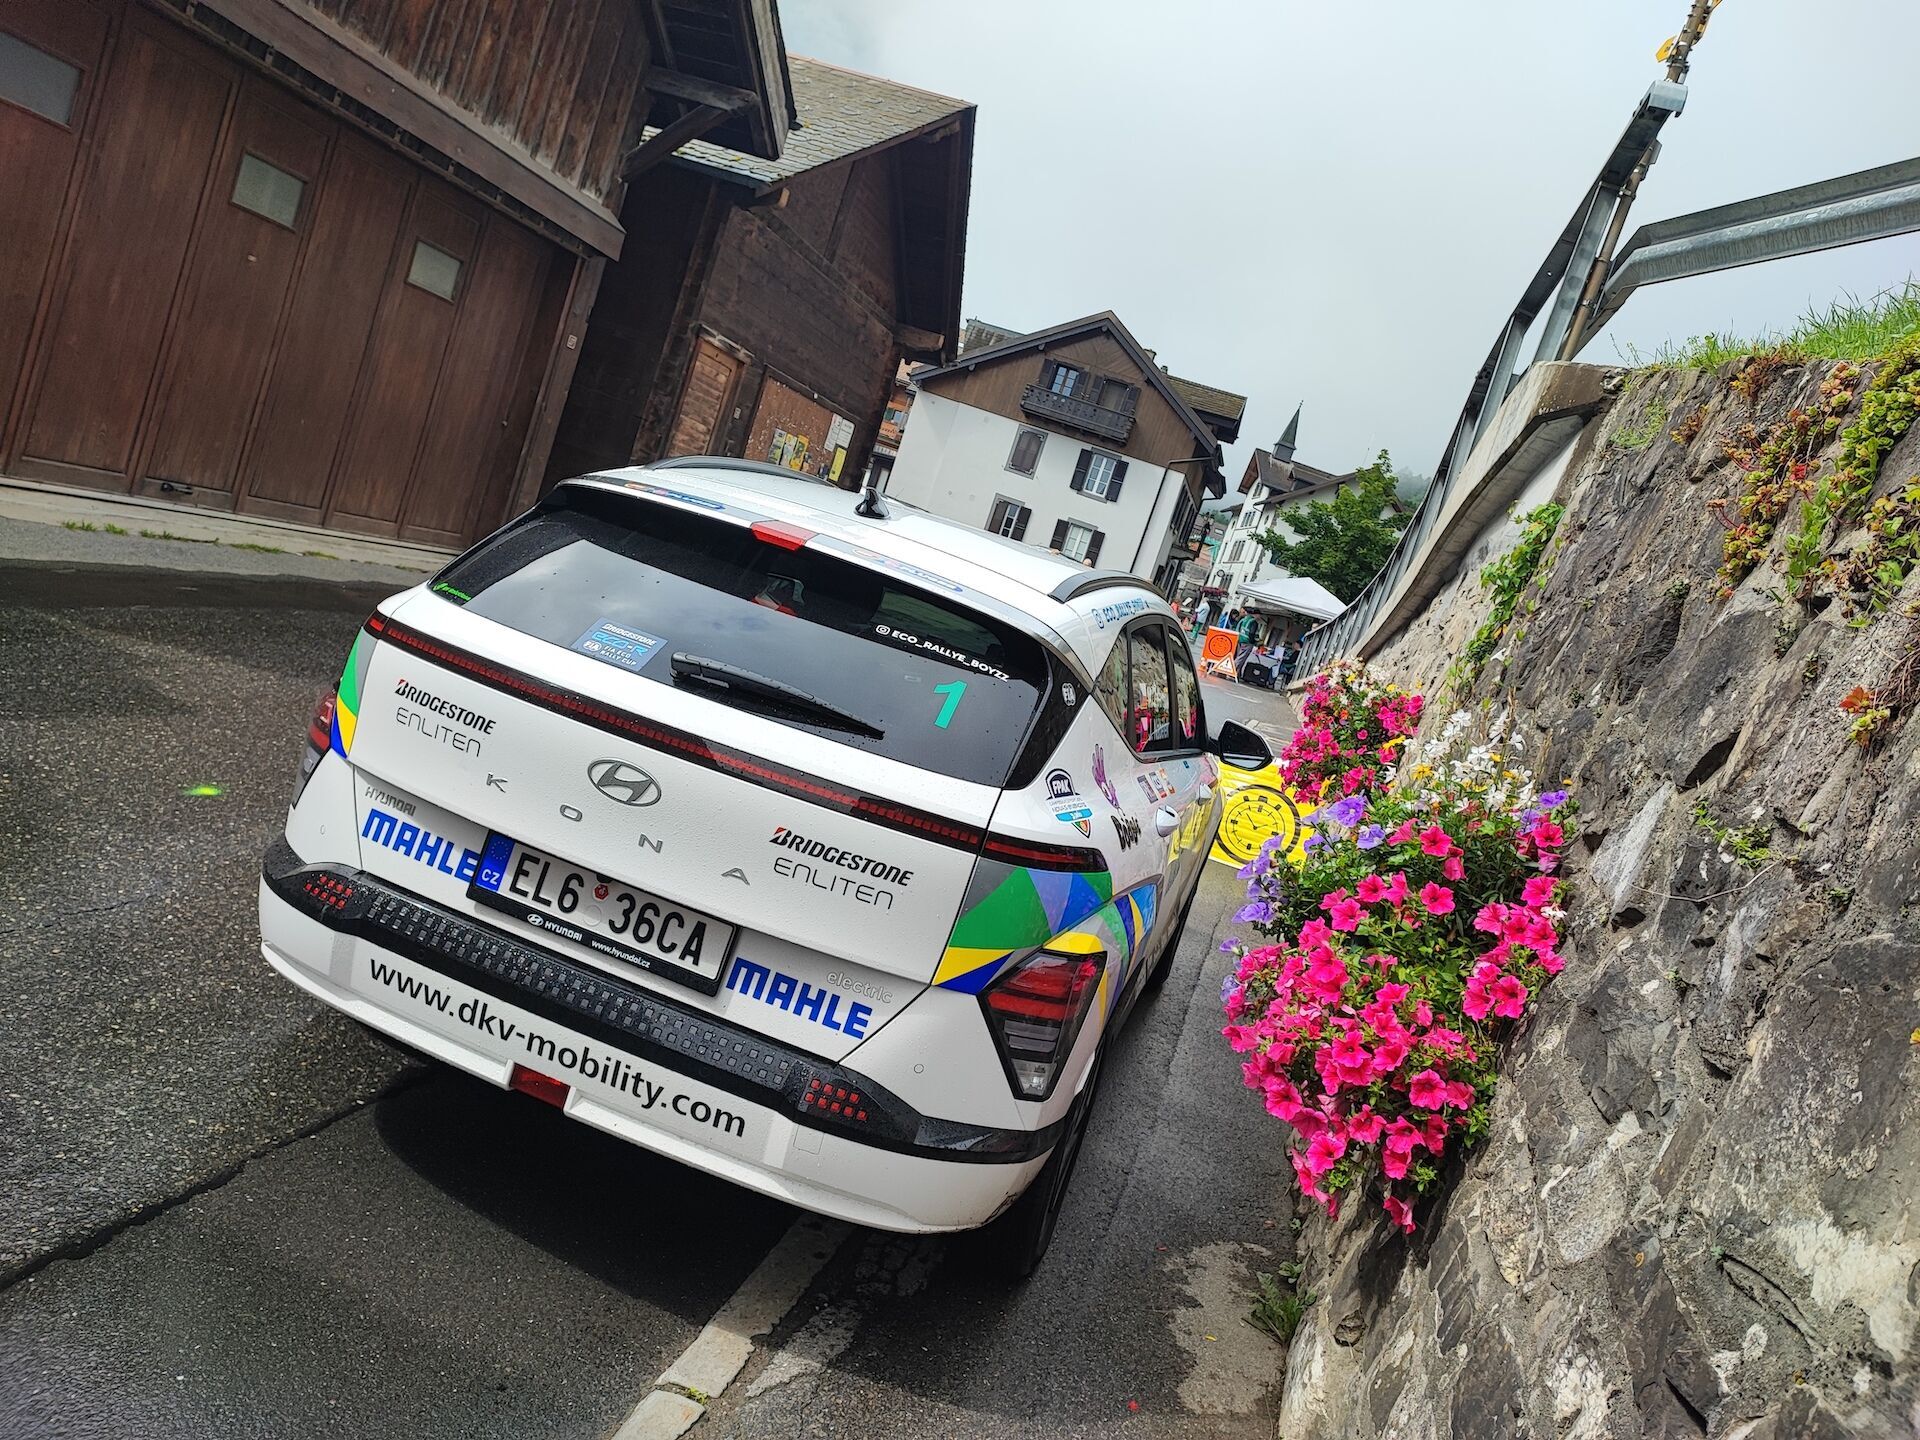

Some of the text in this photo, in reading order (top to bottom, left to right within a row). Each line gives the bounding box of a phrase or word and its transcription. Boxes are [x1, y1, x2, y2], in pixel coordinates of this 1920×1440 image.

[600, 650, 637, 667] RALLY CUP
[601, 623, 657, 646] BRIDGESTONE
[616, 651, 631, 659] ECO
[891, 630, 1010, 682] ECO_RALLYE_BOYZZ
[395, 679, 497, 735] BRIDGESTONE
[933, 680, 968, 729] 1
[396, 707, 482, 757] ENLITEN
[364, 786, 416, 817] HYUNDAI
[1051, 779, 1072, 795] FPAK
[361, 808, 482, 884] MAHLE
[769, 826, 914, 887] BRIDGESTONE
[481, 868, 500, 886] CZ
[773, 857, 894, 909] ENLITEN
[509, 852, 707, 966] EL6 36CA
[544, 920, 583, 942] HYUNDAI
[591, 940, 651, 968] www.hyundai.cz
[726, 957, 873, 1039] MAHLE
[827, 971, 893, 1003] electric
[370, 958, 746, 1138] www.dkv-mobility.com
